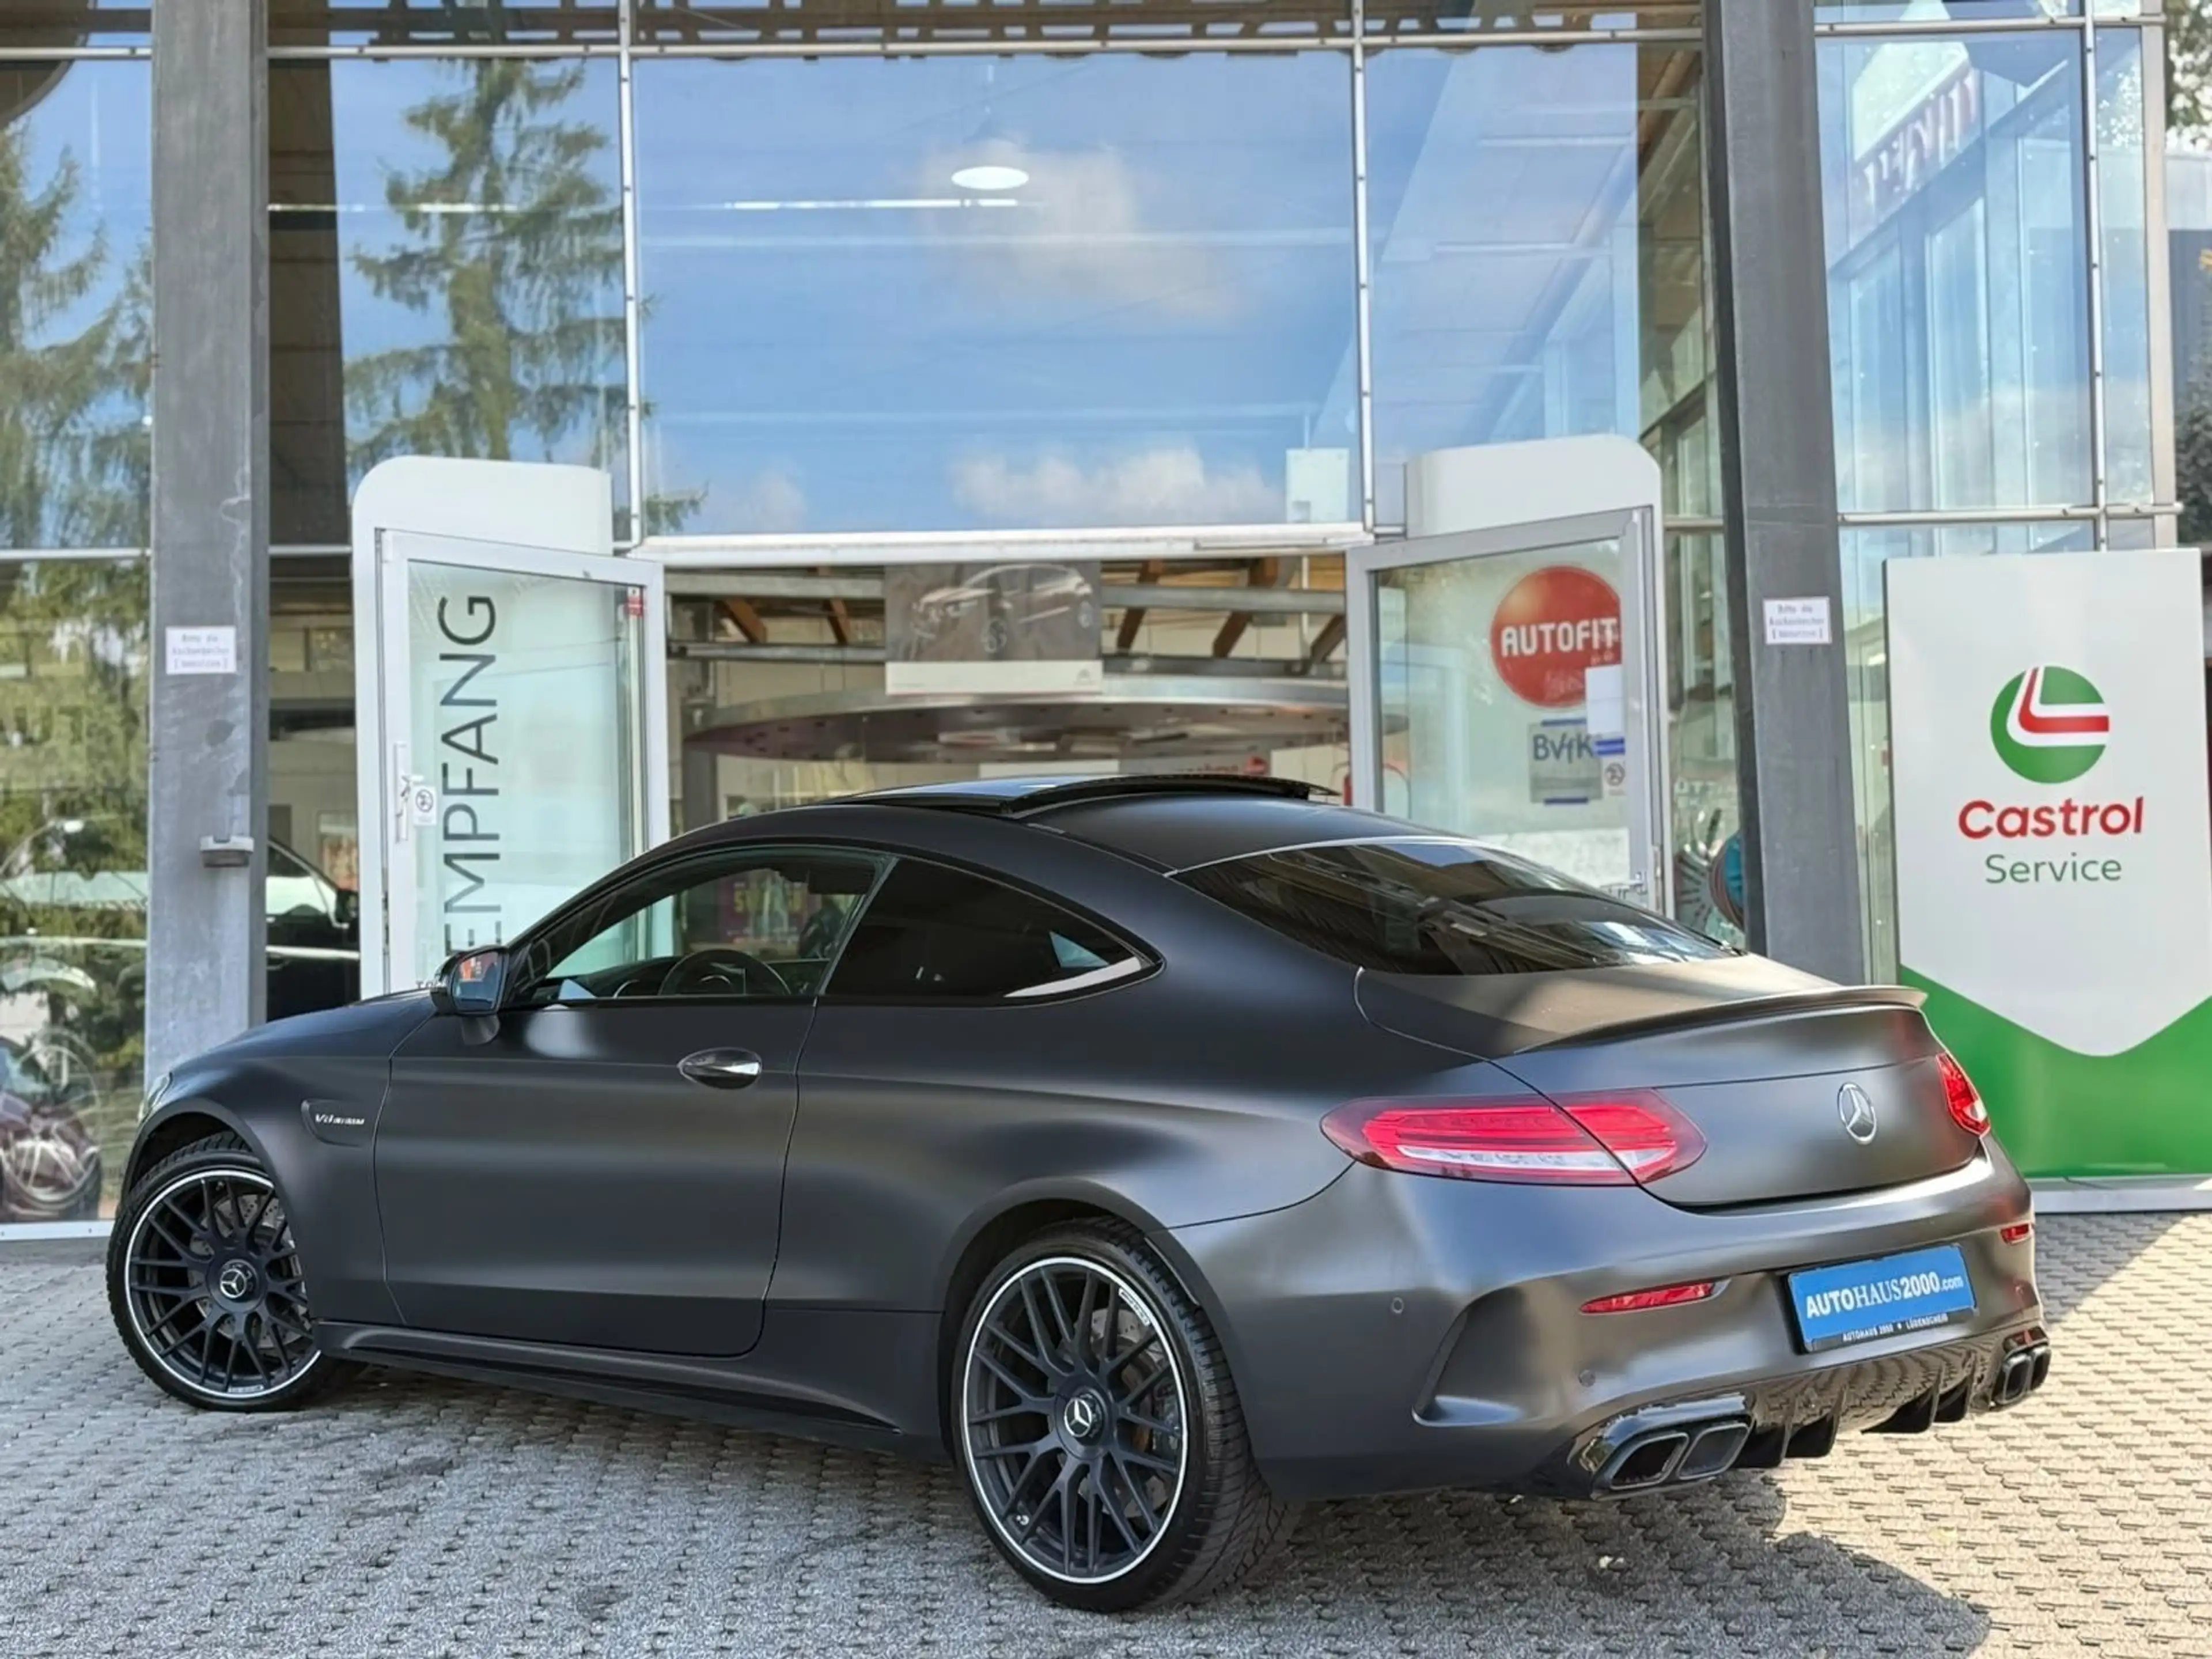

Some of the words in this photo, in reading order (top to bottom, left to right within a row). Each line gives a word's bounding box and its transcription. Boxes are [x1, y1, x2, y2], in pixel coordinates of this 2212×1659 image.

[1501, 618, 1618, 657] AUTOFIT
[438, 596, 501, 957] EMPFANG
[1959, 796, 2143, 839] Castrol
[1985, 853, 2122, 884] Service
